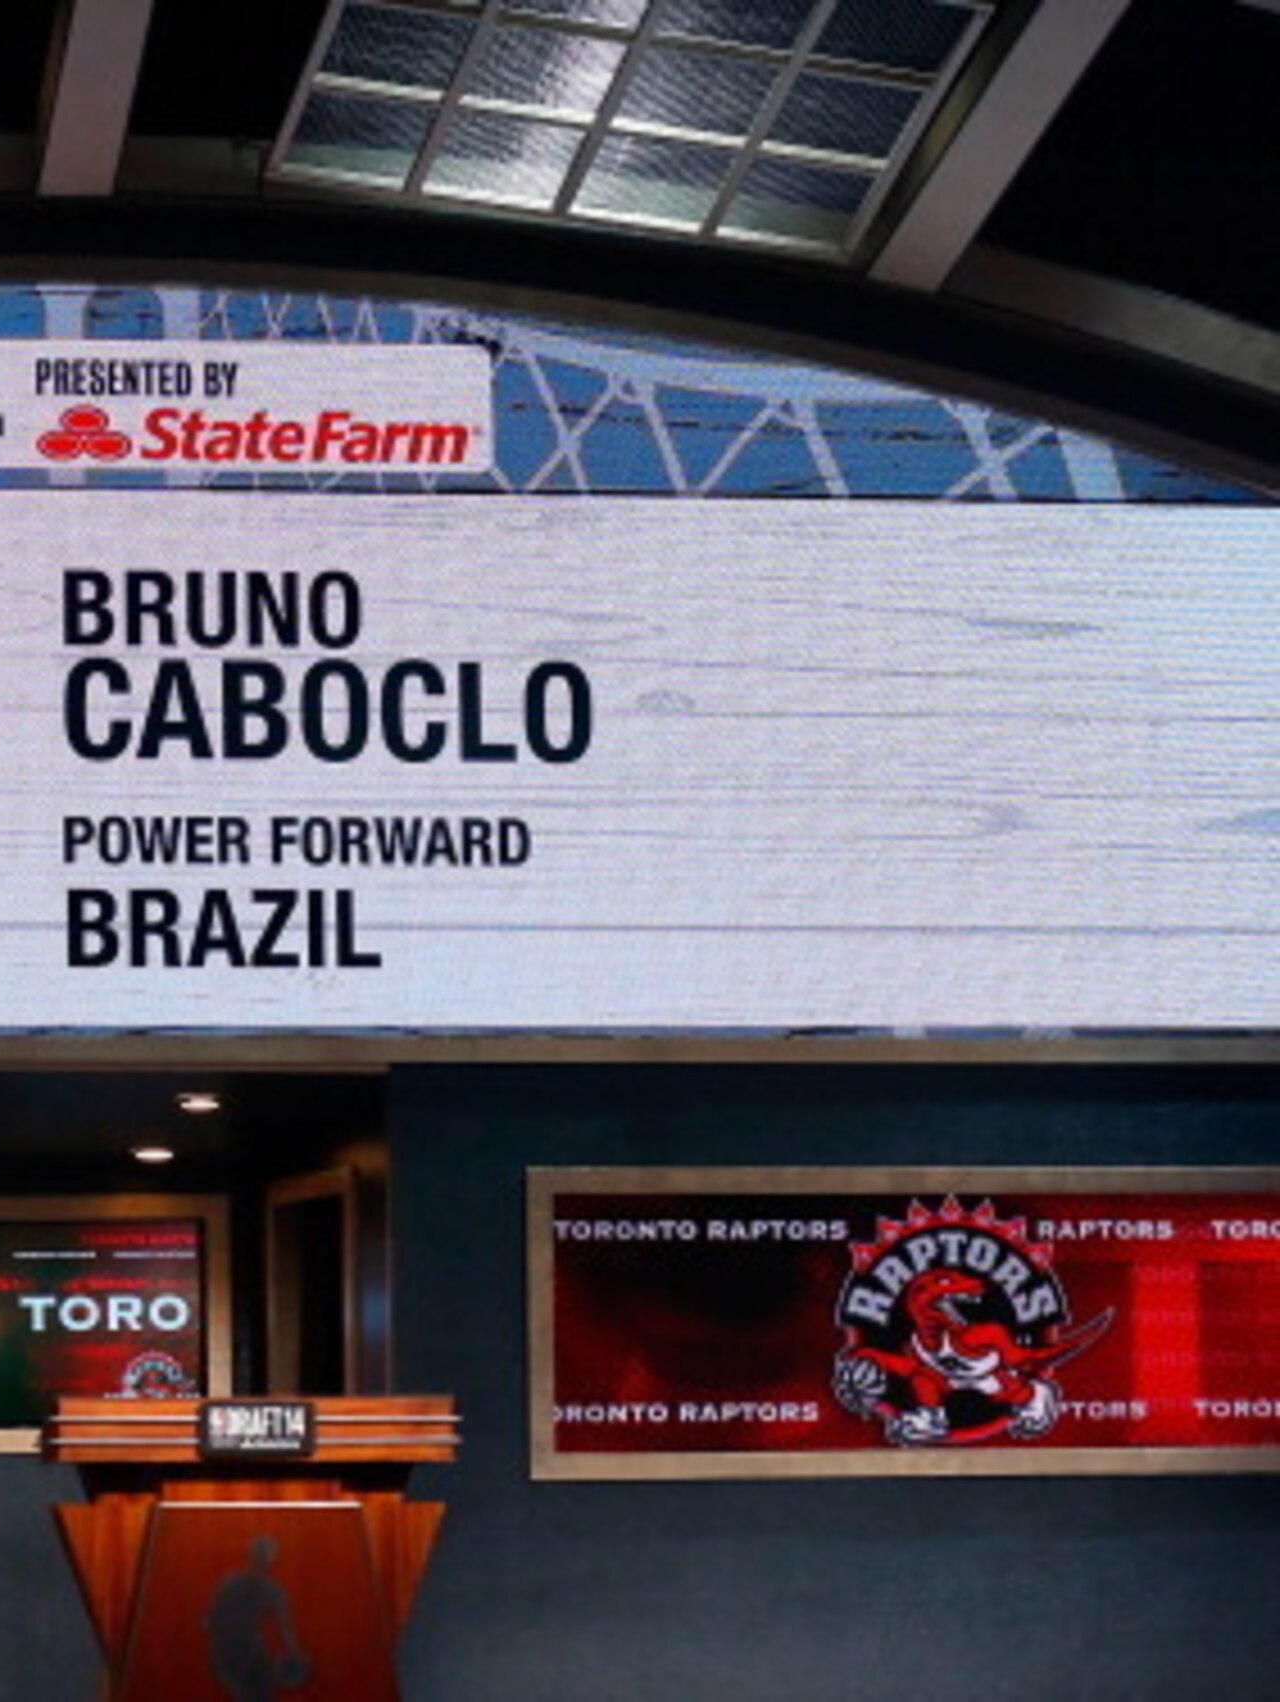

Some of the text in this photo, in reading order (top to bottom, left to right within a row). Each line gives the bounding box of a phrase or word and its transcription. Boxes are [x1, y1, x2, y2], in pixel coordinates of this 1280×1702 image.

[35, 359, 238, 396] PRESENTED BY
[63, 569, 361, 650] BRUNO
[64, 658, 593, 764] CABOCLO
[63, 815, 531, 867] POWER FORWARD
[66, 888, 382, 968] BRAZIL
[553, 1220, 699, 1241] TORONTO
[707, 1220, 848, 1241] RAPTORS
[1037, 1220, 1175, 1240] RAPTORS
[845, 1229, 1058, 1324] RAPTORS
[19, 1294, 190, 1332] TORO
[679, 1402, 819, 1423] RAPTORS
